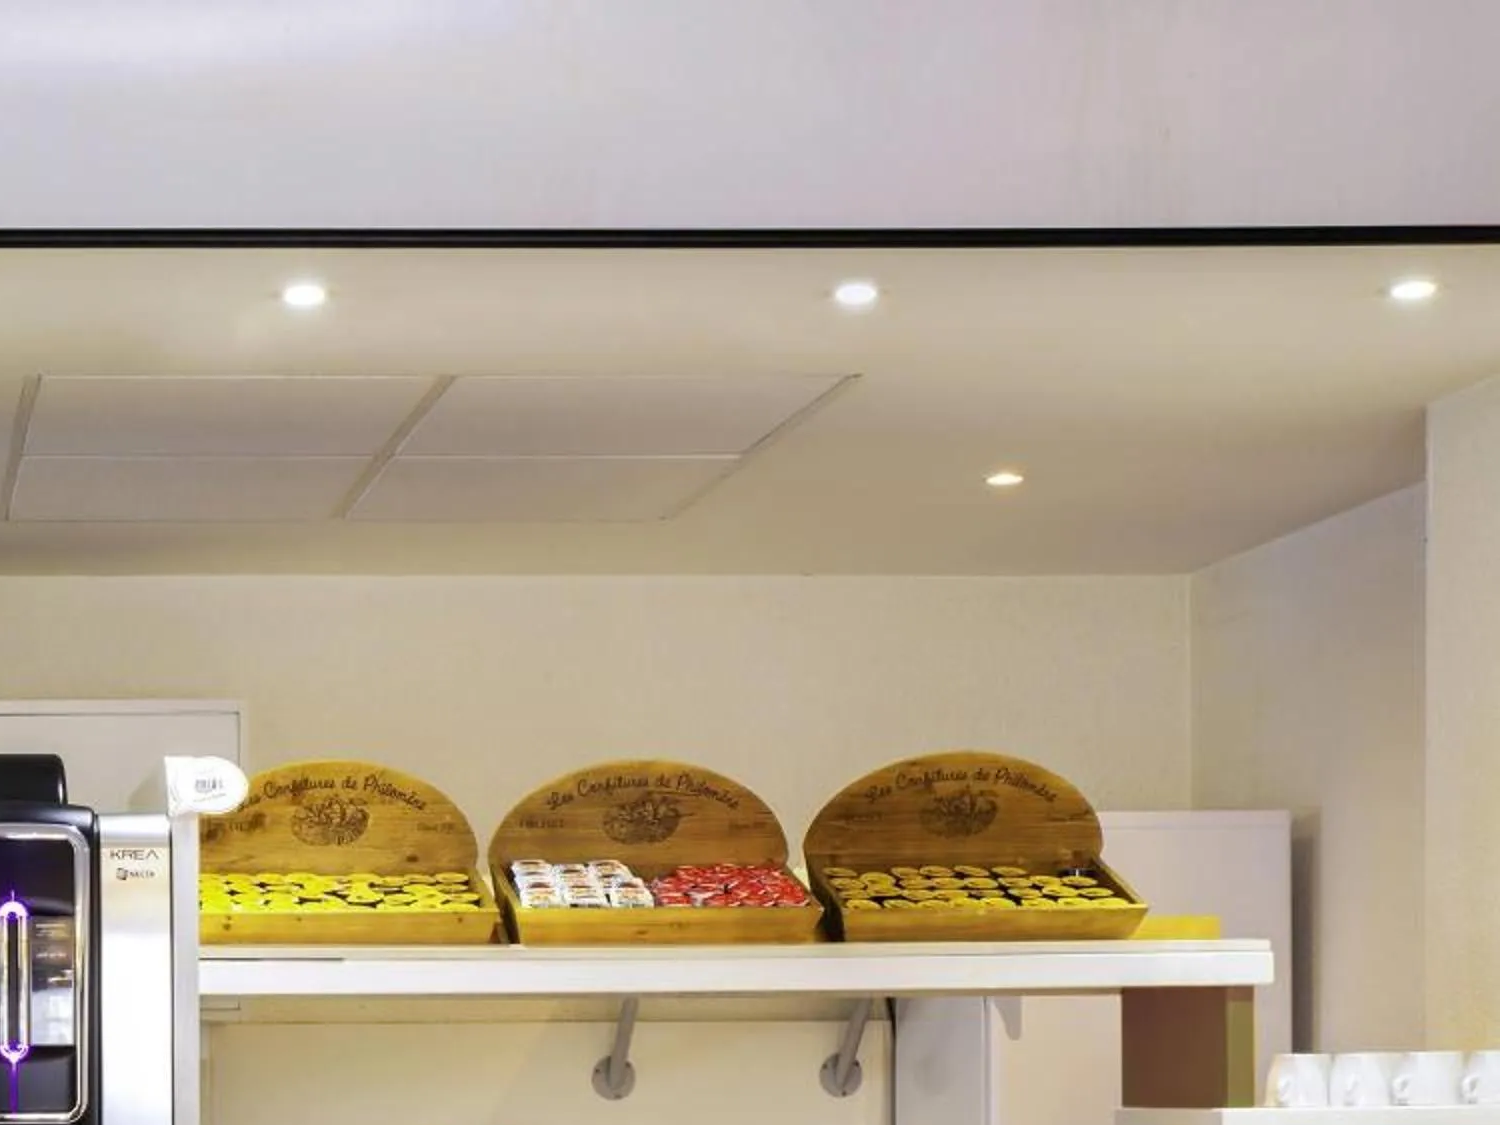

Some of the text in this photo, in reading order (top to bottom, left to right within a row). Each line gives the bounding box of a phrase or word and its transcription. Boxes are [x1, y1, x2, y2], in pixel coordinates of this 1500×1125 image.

[263, 777, 335, 799] Confitures
[341, 776, 358, 789] de
[546, 791, 574, 810] Les
[578, 776, 649, 798] Confitures
[656, 775, 671, 789] de
[865, 785, 892, 805] Les
[896, 768, 967, 791] Confitures
[973, 767, 989, 781] de
[109, 849, 159, 860] KREA
